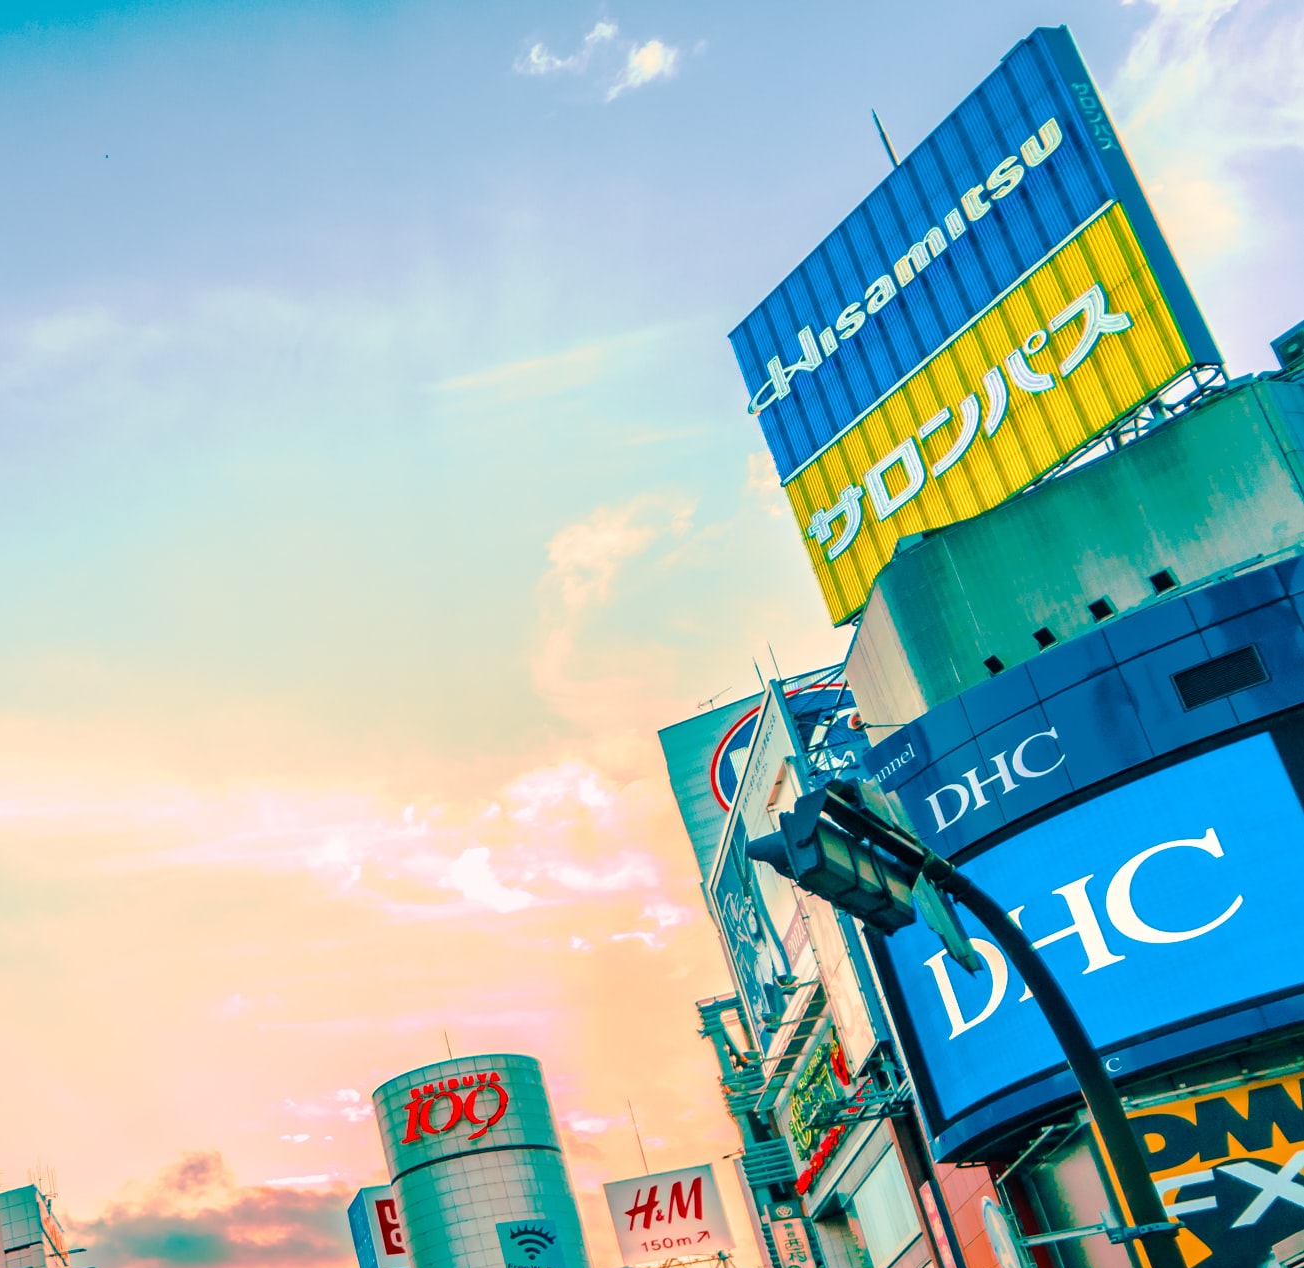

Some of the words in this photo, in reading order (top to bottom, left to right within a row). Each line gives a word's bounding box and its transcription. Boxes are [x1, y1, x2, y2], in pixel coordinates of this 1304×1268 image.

[747, 117, 1062, 415] Hisamitsu
[807, 284, 1133, 562] サロンパス
[925, 727, 1066, 834] DHC
[923, 827, 1245, 1041] DHC
[401, 1083, 509, 1144] 109
[411, 1071, 500, 1099] SHIBUYA
[624, 1176, 703, 1231] H&M
